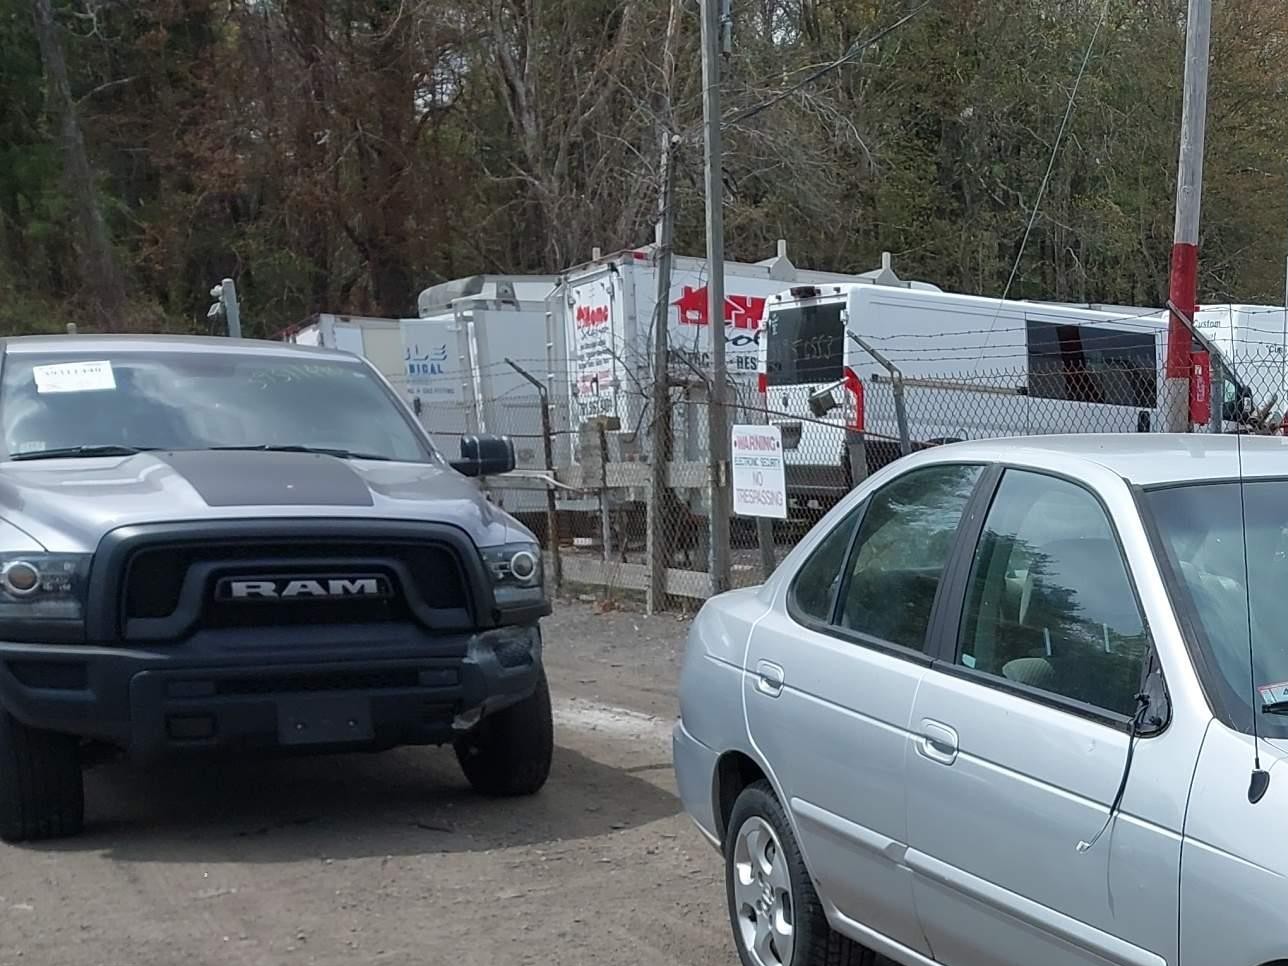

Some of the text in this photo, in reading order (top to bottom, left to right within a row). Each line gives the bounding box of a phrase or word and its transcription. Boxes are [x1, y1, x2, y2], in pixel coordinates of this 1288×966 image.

[736, 435, 777, 451] WARNING
[752, 471, 764, 487] NO
[736, 488, 784, 506] TRESPASSING
[231, 579, 379, 597] RAM
